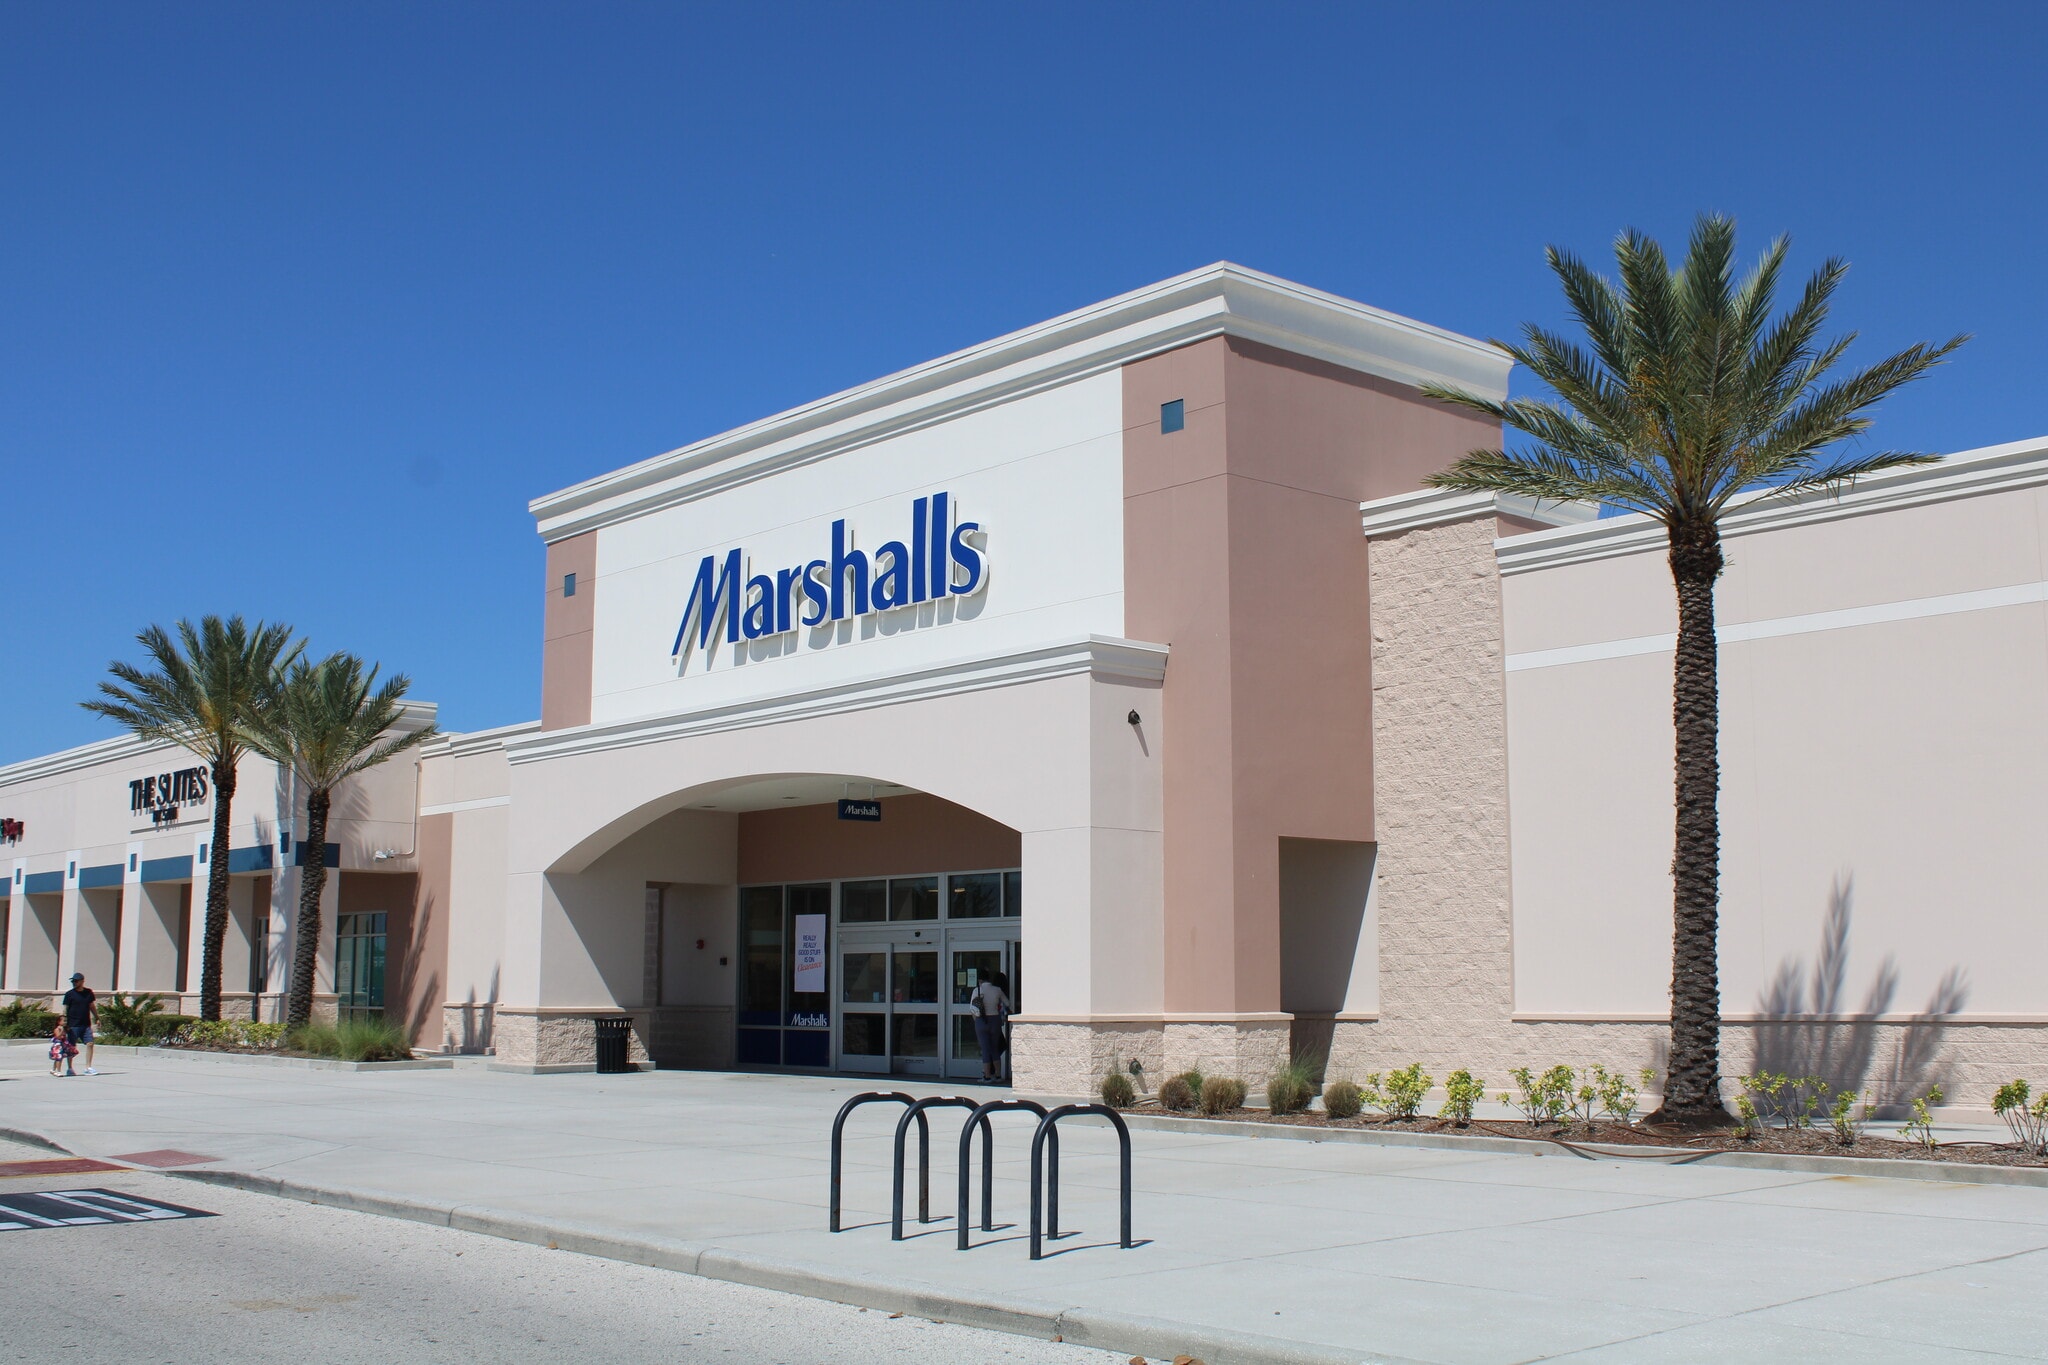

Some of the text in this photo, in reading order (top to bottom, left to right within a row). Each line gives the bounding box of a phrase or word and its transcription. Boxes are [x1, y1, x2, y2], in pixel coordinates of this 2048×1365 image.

[671, 491, 984, 657] Marshalls
[129, 765, 208, 810] THE SUITES
[844, 804, 879, 816] Marshalls
[791, 1013, 827, 1027] Marshalls
